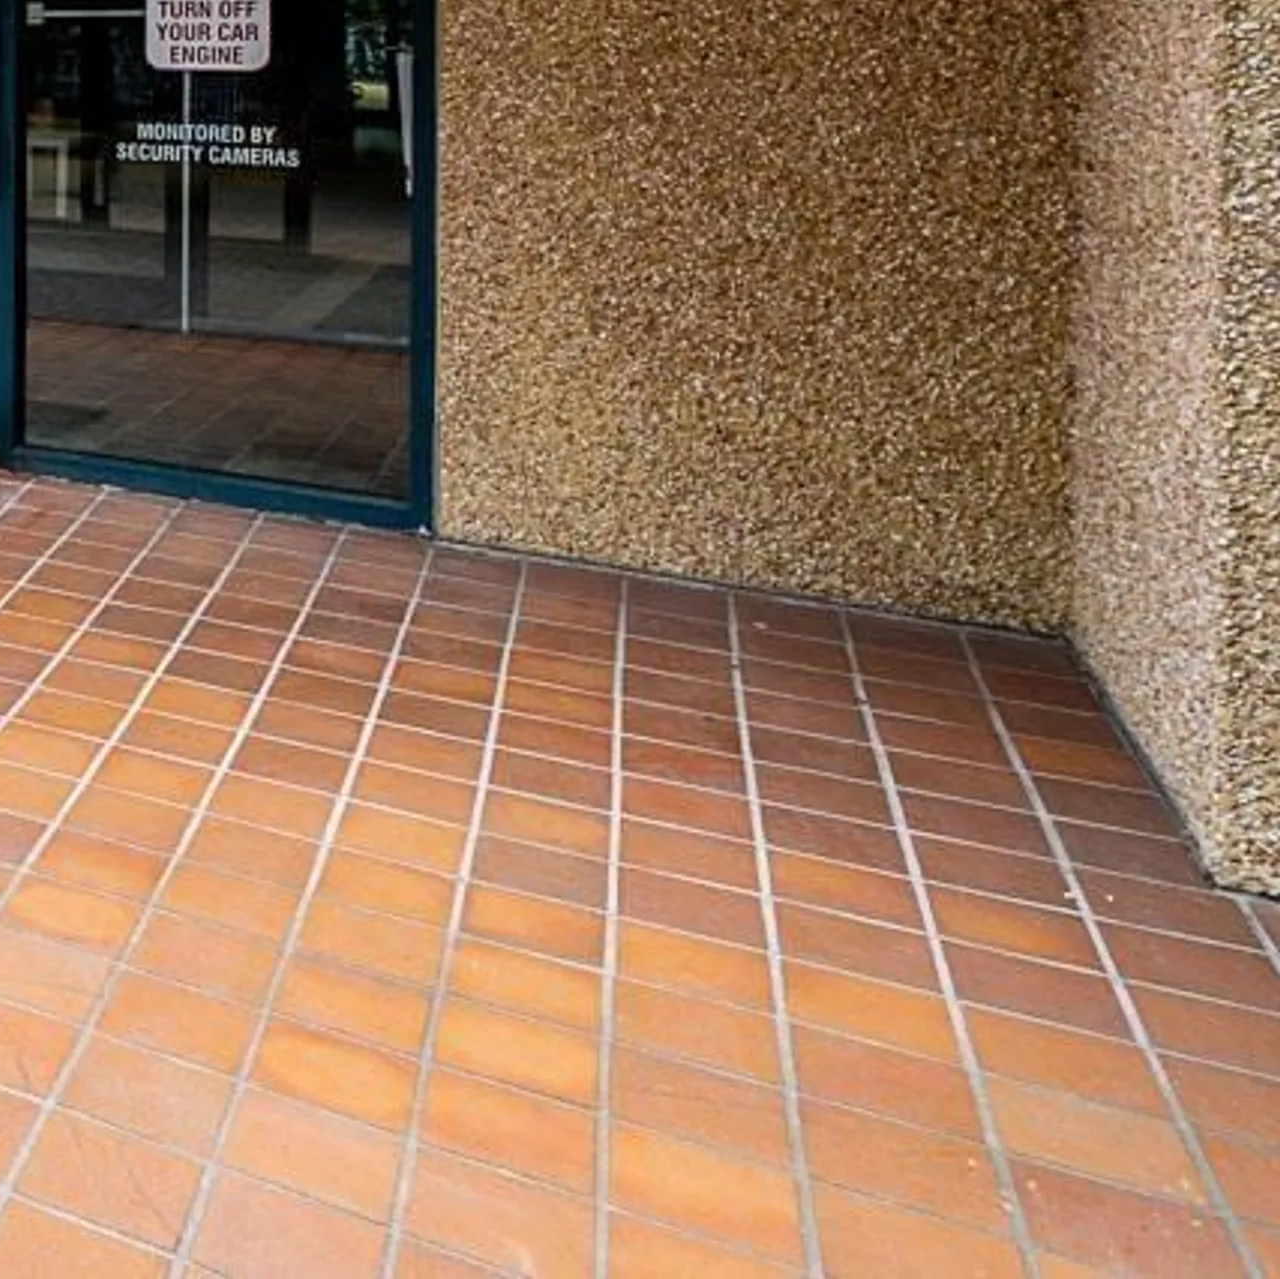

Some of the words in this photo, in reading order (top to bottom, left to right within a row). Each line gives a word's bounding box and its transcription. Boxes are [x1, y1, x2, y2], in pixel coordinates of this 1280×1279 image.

[157, 0, 211, 19] TURN
[219, 0, 259, 19] OFF
[157, 23, 211, 41] YOUR
[218, 23, 259, 41] CAR
[170, 46, 244, 64] ENGINE
[137, 123, 246, 142] MONITORED
[250, 125, 277, 144] BY
[115, 143, 203, 162] SECURITY
[208, 147, 301, 168] CAMERAS
